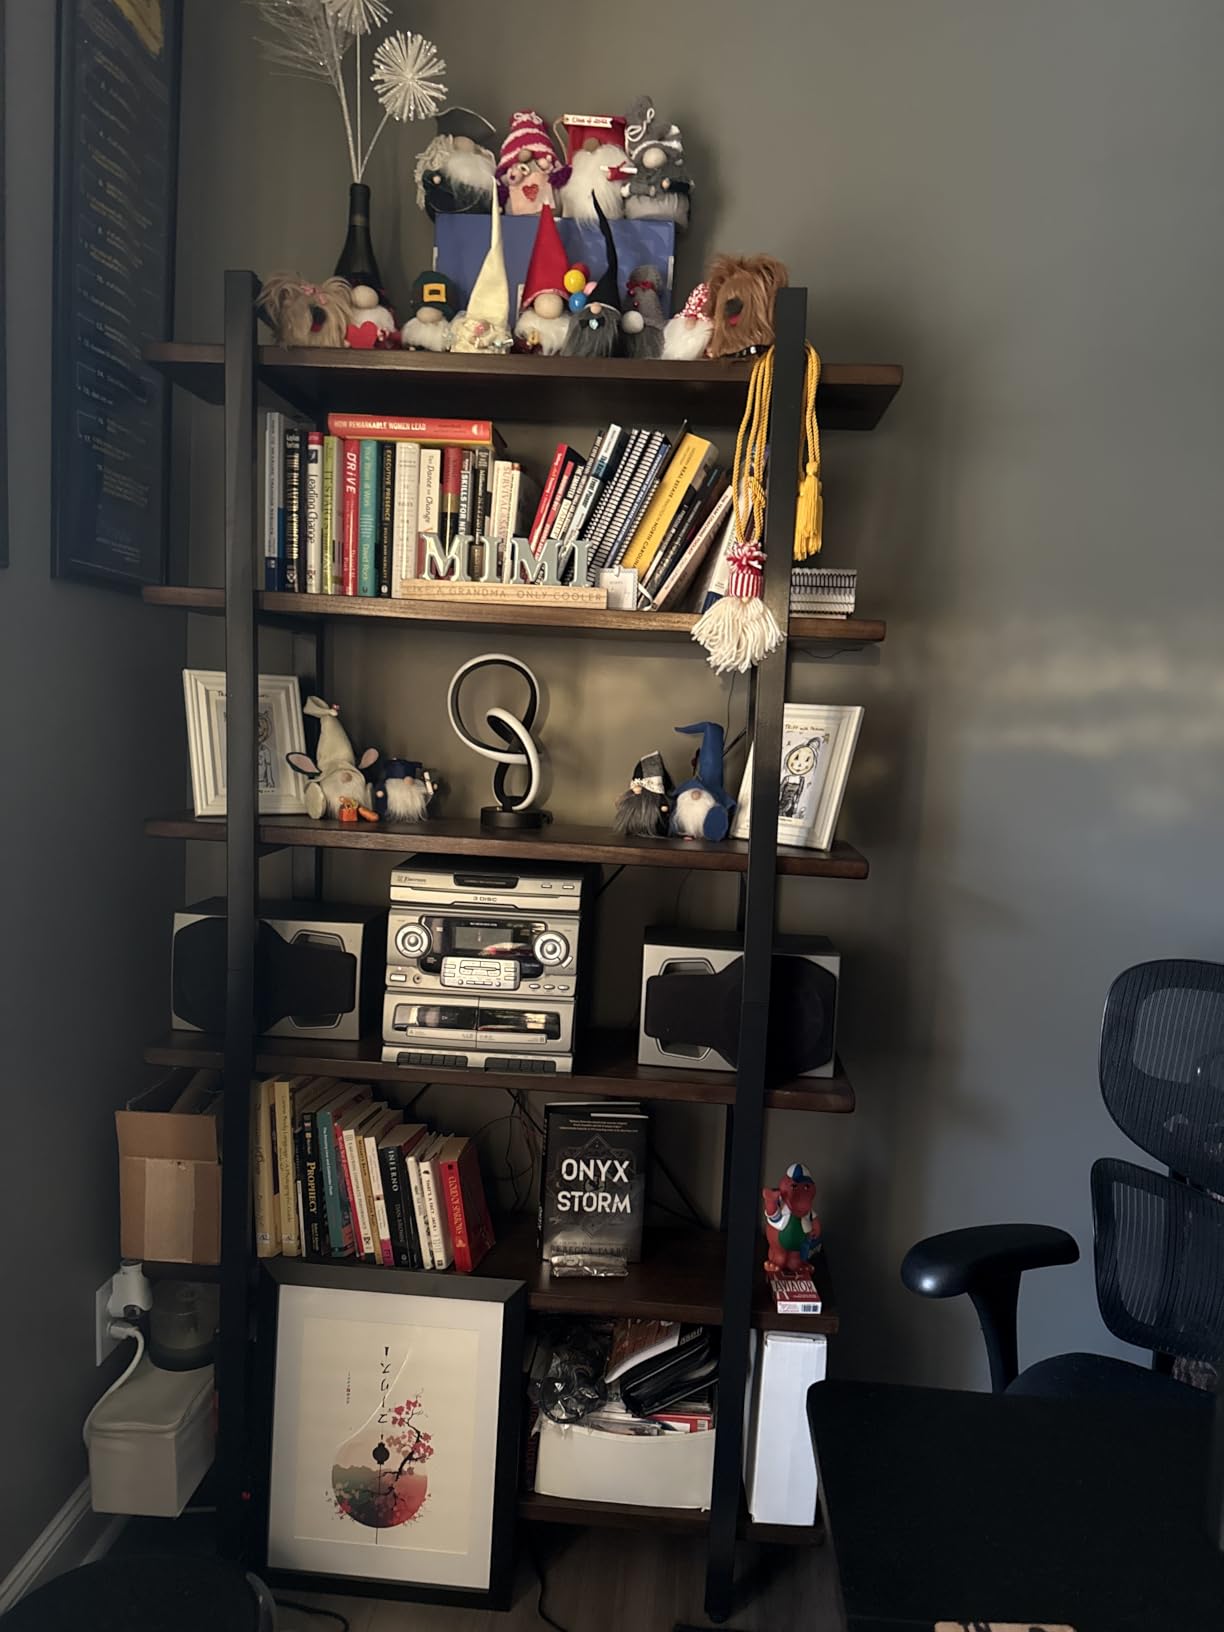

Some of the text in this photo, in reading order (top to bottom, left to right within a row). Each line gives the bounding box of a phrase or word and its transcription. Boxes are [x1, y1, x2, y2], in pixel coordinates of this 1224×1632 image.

[333, 420, 347, 428] HOW
[349, 421, 388, 429] REMARKABLE
[389, 422, 411, 431] WOMEN
[411, 423, 426, 431] LEAD
[363, 445, 371, 460] Your
[345, 451, 356, 494] DRIVE
[425, 464, 434, 488] Dance
[566, 464, 584, 499] THE SMARTER
[642, 453, 662, 488] FOUNDATIONS
[676, 464, 687, 479] REAL
[459, 473, 468, 501] SKILLS
[498, 465, 512, 512] SURVIVAL
[587, 477, 597, 491] Event
[666, 478, 681, 498] ESTATE
[363, 489, 371, 507] Work
[383, 487, 391, 521] PRESENCE
[581, 490, 592, 508] Planner
[635, 490, 644, 503] REAL
[307, 474, 318, 544] Leading Change
[423, 495, 433, 523] Change
[458, 503, 466, 518] FOR
[627, 502, 638, 519] ESTATE
[712, 502, 723, 516] TEAM
[615, 517, 631, 542] INVESTING
[645, 521, 659, 541] NORTH
[422, 534, 593, 588] MIMI
[629, 540, 650, 569] CAROLINA
[361, 564, 369, 581] Rock
[517, 590, 548, 600] ONLY
[553, 591, 601, 602] COOLER
[387, 1149, 399, 1192] INFERNO
[561, 1158, 630, 1182] ONYX
[304, 1161, 319, 1215] PROPHECY
[446, 1175, 458, 1198] CLOUD
[557, 1191, 632, 1214] STORM
[770, 1280, 818, 1299] AVIATOR
